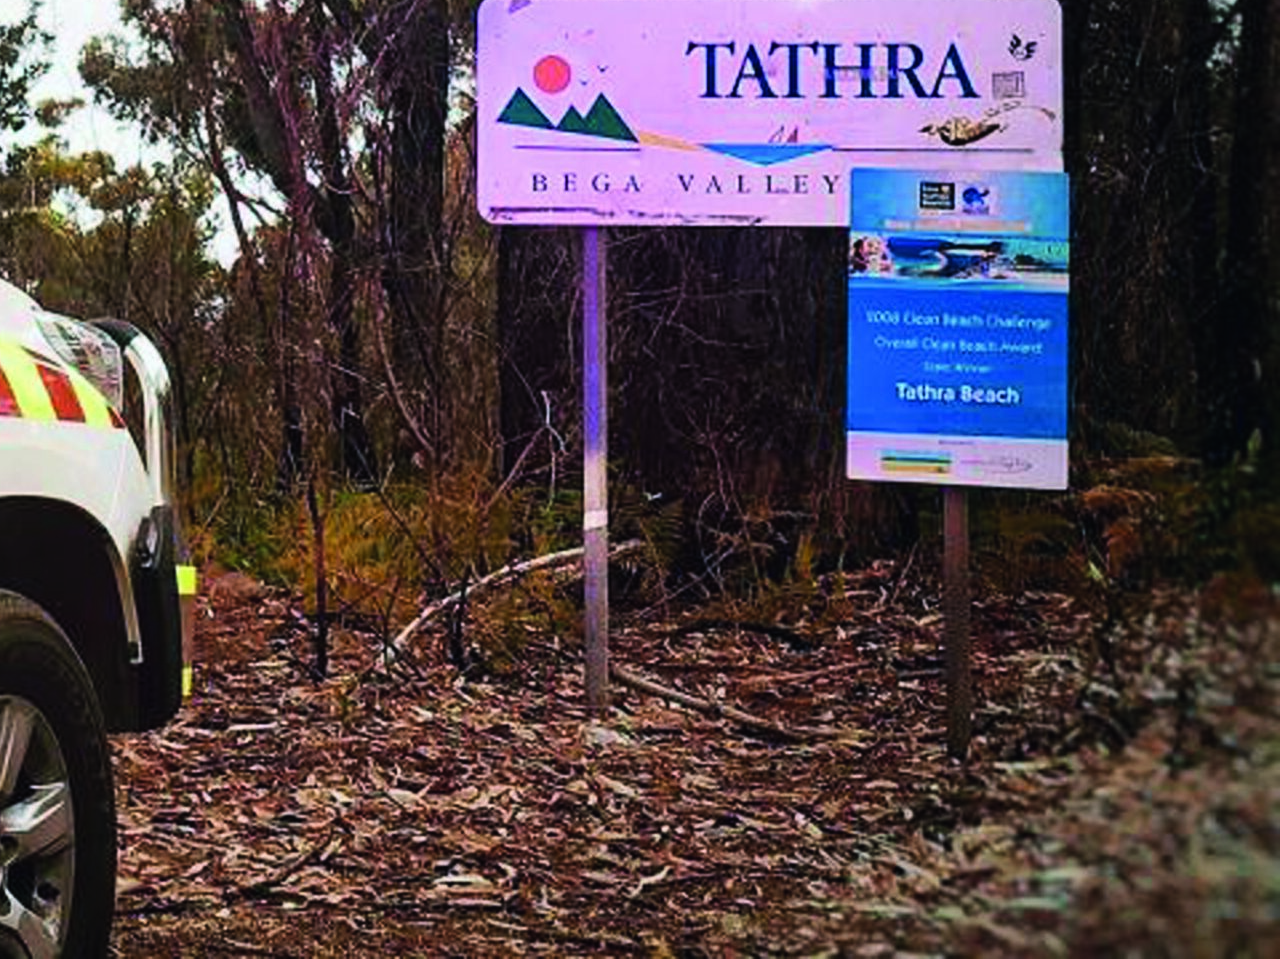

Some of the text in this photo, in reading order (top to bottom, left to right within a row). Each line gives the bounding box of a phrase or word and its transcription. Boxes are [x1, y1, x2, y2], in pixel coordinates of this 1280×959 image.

[685, 41, 980, 99] TATHRA
[531, 173, 841, 195] BEGA VALLEY
[896, 382, 1020, 405] Tathra Beach
